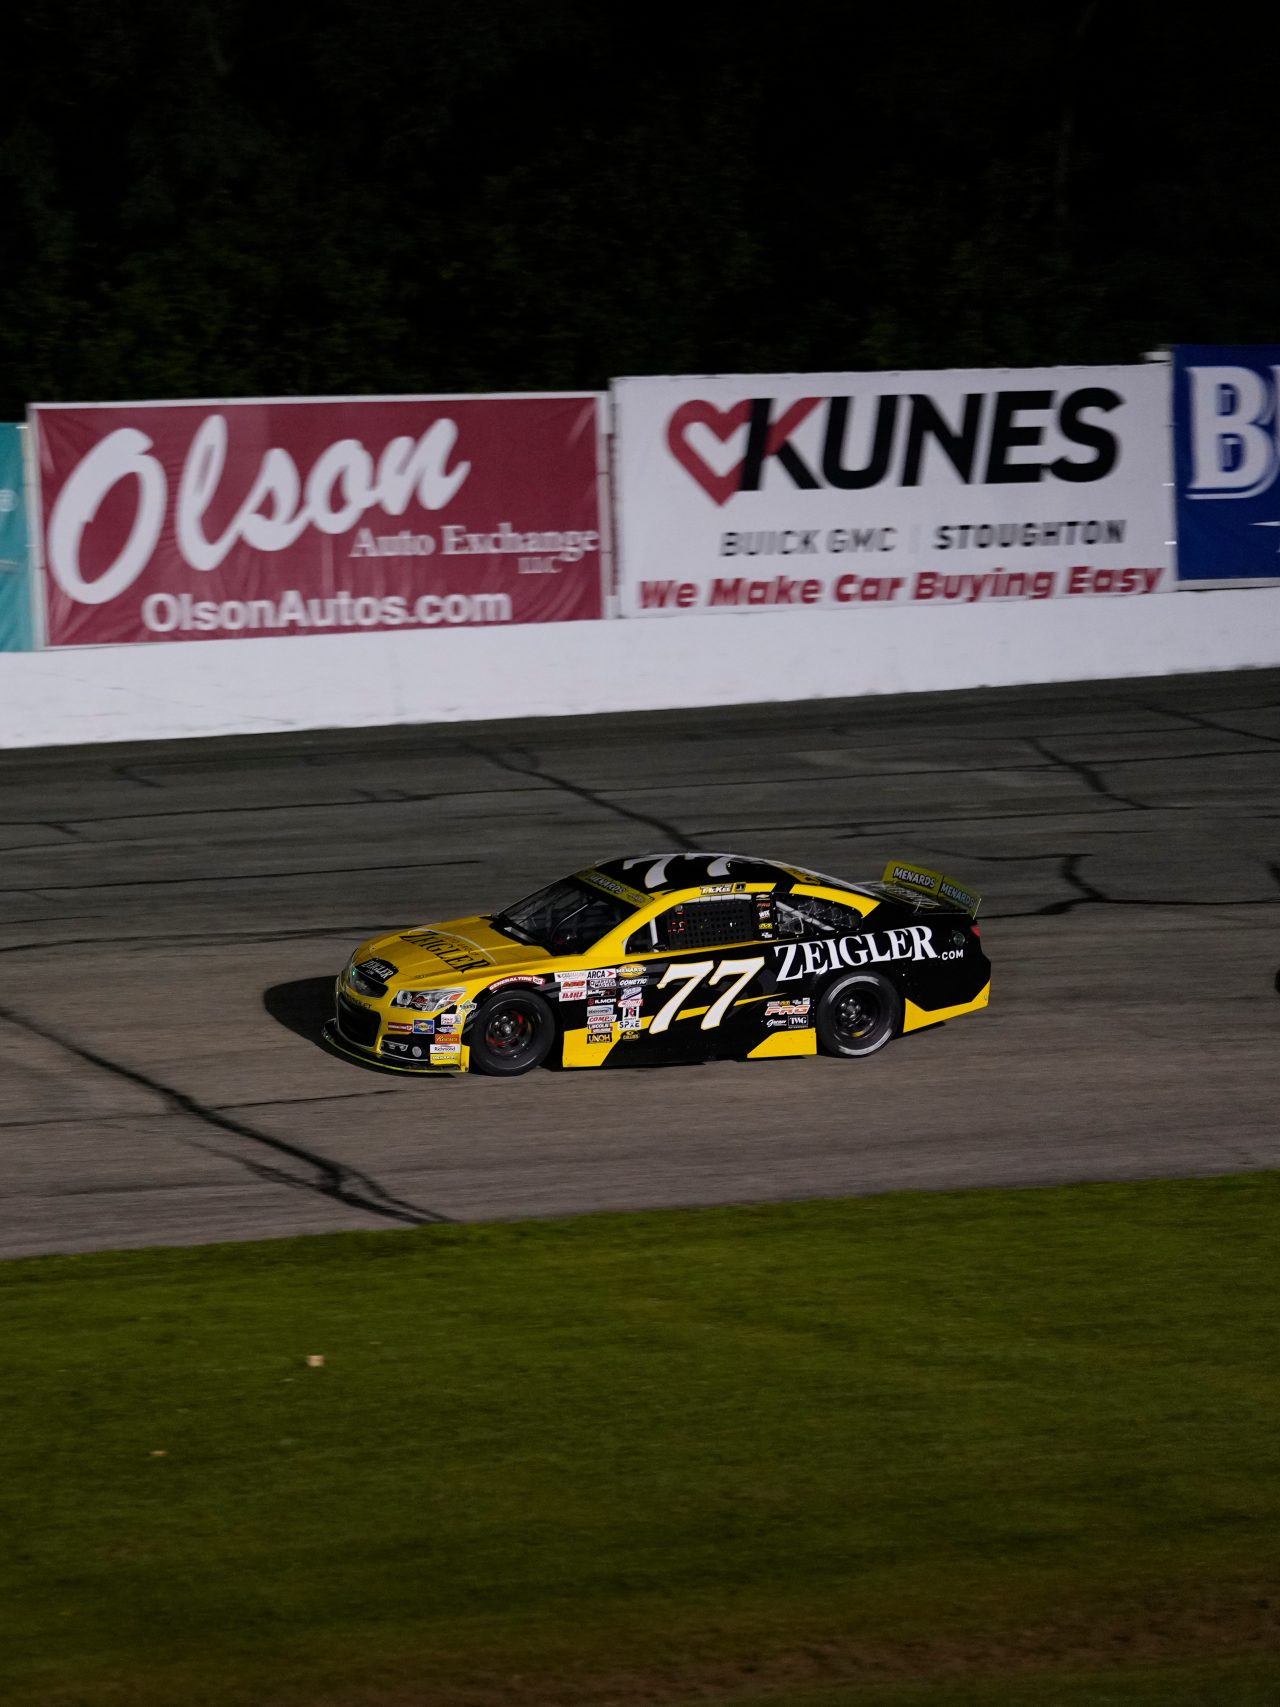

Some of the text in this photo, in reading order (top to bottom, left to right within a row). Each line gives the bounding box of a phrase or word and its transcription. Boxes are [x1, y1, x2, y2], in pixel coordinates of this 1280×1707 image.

[739, 387, 1126, 491] KUNES
[1183, 364, 1280, 501] B
[49, 414, 471, 604] Olson
[349, 523, 600, 563] Auto Exchange
[721, 526, 897, 557] BUICK GMC
[932, 518, 1127, 551] STOUGHTON
[639, 565, 1165, 609] We Make Car Buying Easy
[142, 590, 513, 633] OlsonAutos.com
[893, 867, 936, 888] MENARDS
[940, 883, 976, 908] MENARDS
[774, 925, 939, 982] ZEIGLER
[587, 970, 606, 978] ARCA
[648, 956, 766, 1035] 77
[765, 1004, 811, 1016] PRG
[588, 1034, 612, 1042] UNOH
[790, 1016, 807, 1025] TWG
